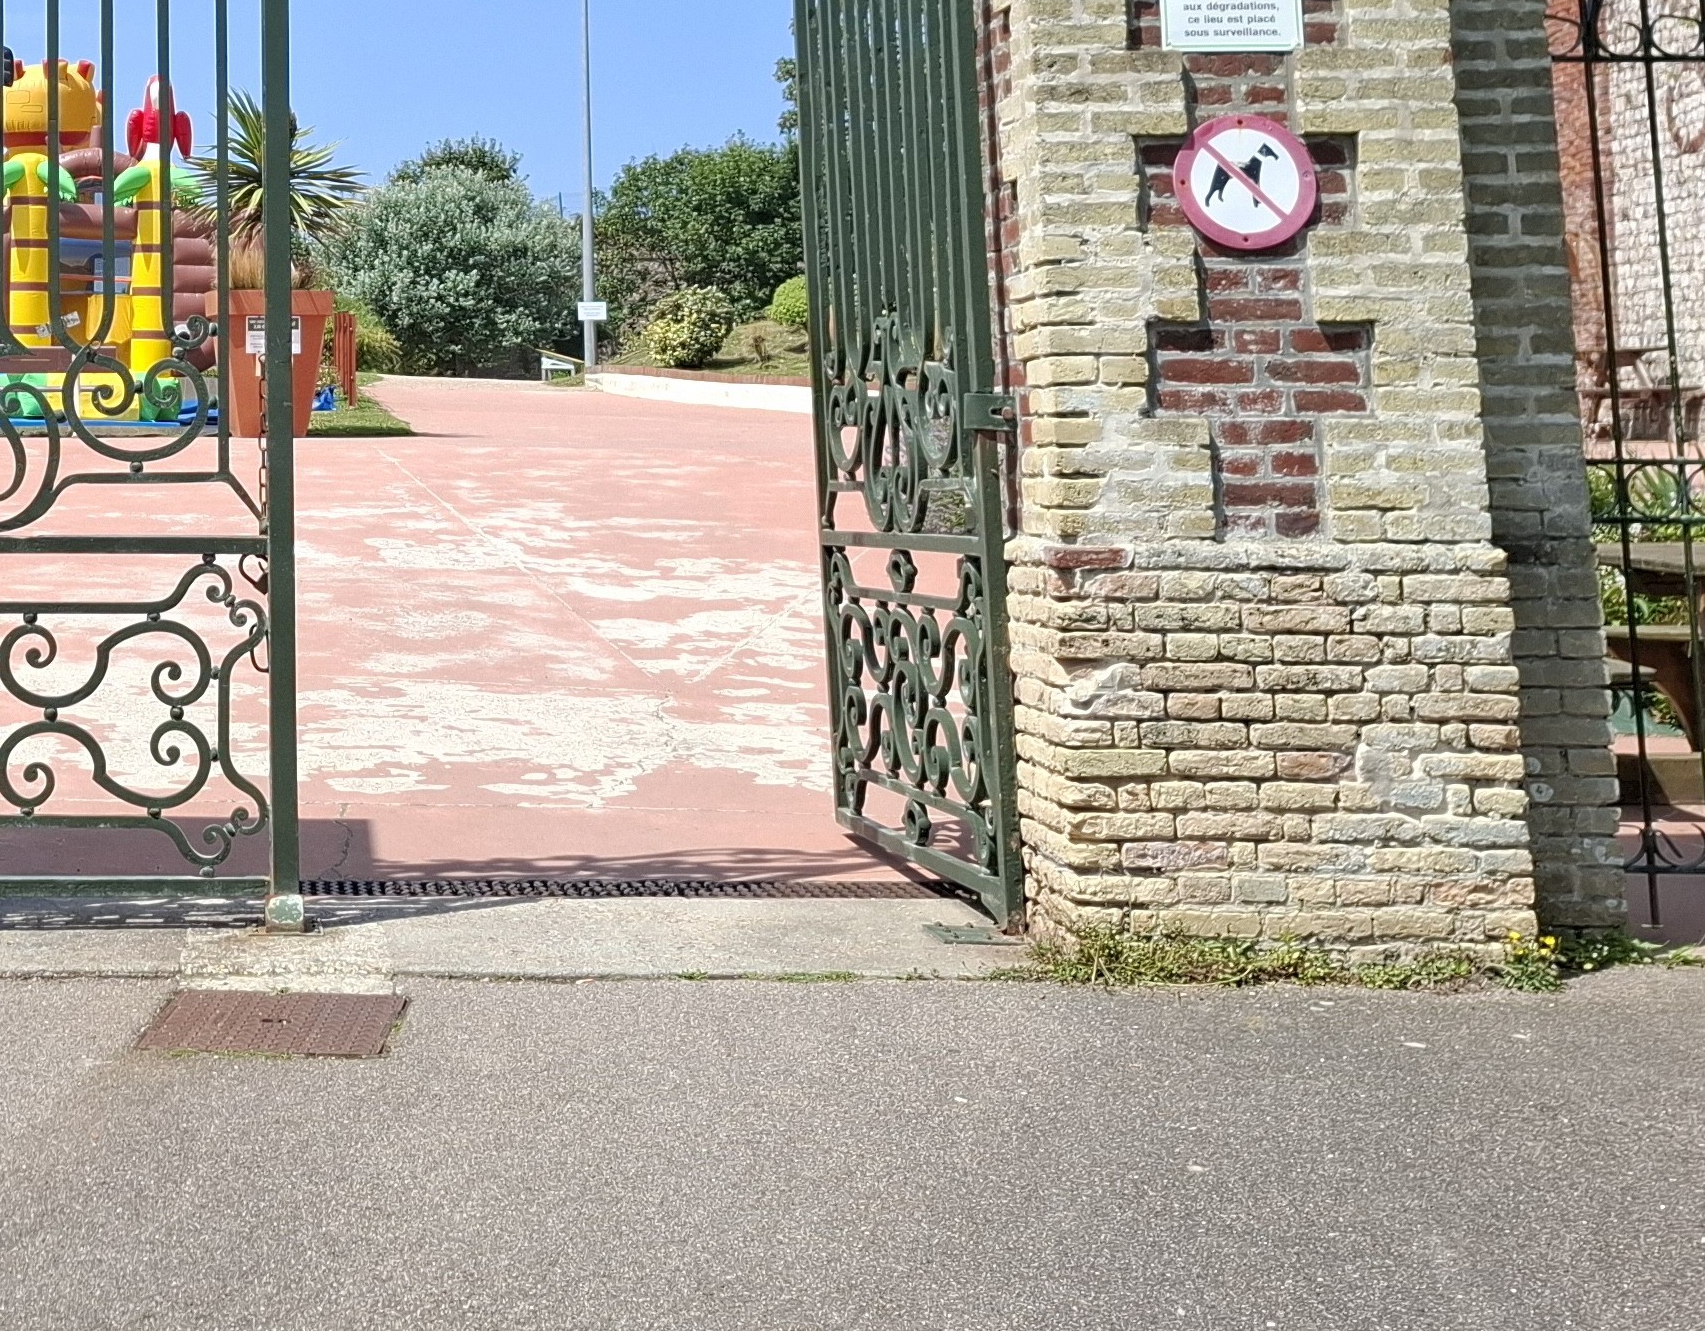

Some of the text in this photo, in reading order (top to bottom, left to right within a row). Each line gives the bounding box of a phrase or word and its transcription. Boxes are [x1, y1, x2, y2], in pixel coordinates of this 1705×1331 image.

[1182, 1, 1279, 13] aux dégradations,
[1187, 14, 1276, 25] ce lieu est placé
[1184, 27, 1282, 37] sous surveillance.
